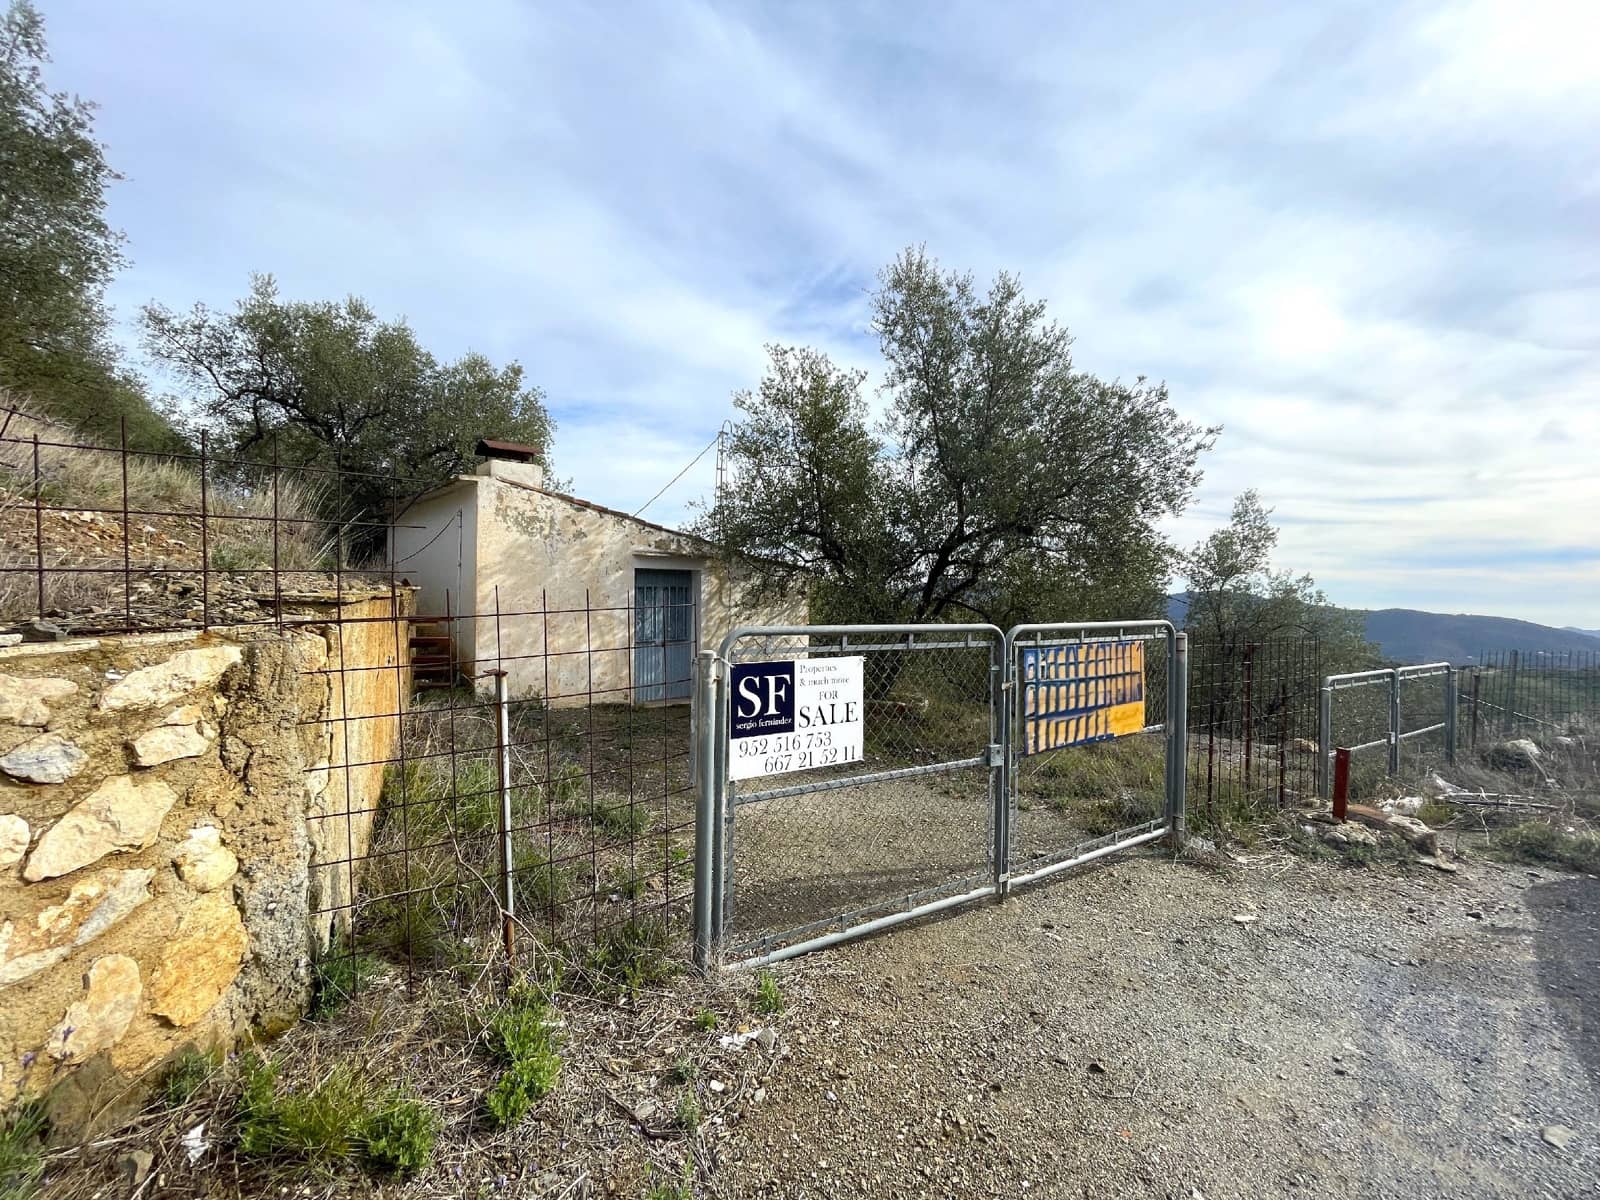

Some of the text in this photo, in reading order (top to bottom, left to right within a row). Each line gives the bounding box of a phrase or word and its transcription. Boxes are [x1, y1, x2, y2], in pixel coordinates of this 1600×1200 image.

[799, 664, 837, 673] Properties
[737, 675, 791, 718] SF
[819, 691, 839, 700] FOR
[736, 721, 758, 730] sergio
[799, 702, 858, 728] SALE
[739, 731, 832, 758] 952 516 753
[765, 754, 792, 773] 667
[799, 752, 813, 768] 21
[820, 748, 837, 765] 52
